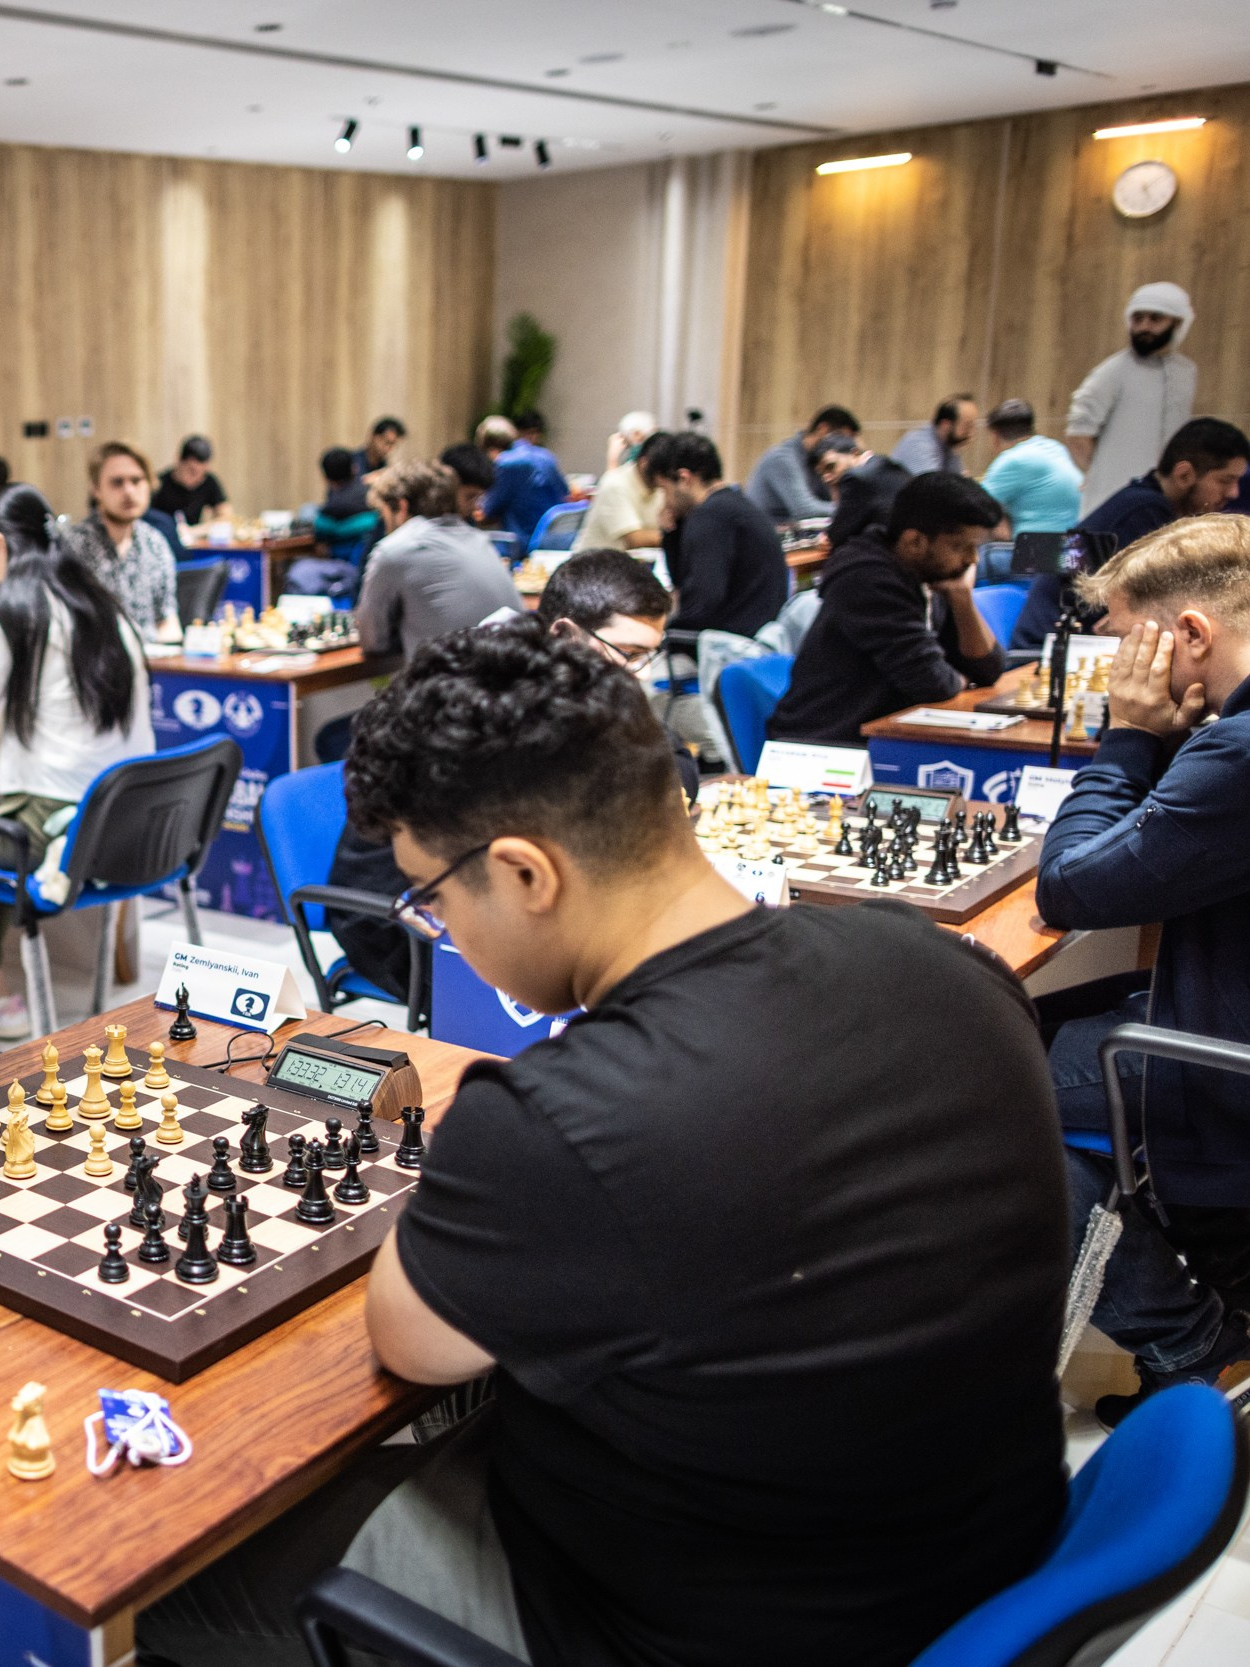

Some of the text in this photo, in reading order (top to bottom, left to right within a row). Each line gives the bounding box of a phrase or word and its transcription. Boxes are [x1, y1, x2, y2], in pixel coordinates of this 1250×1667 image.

[174, 952, 259, 979] GM Zemlyanskii, Ivan
